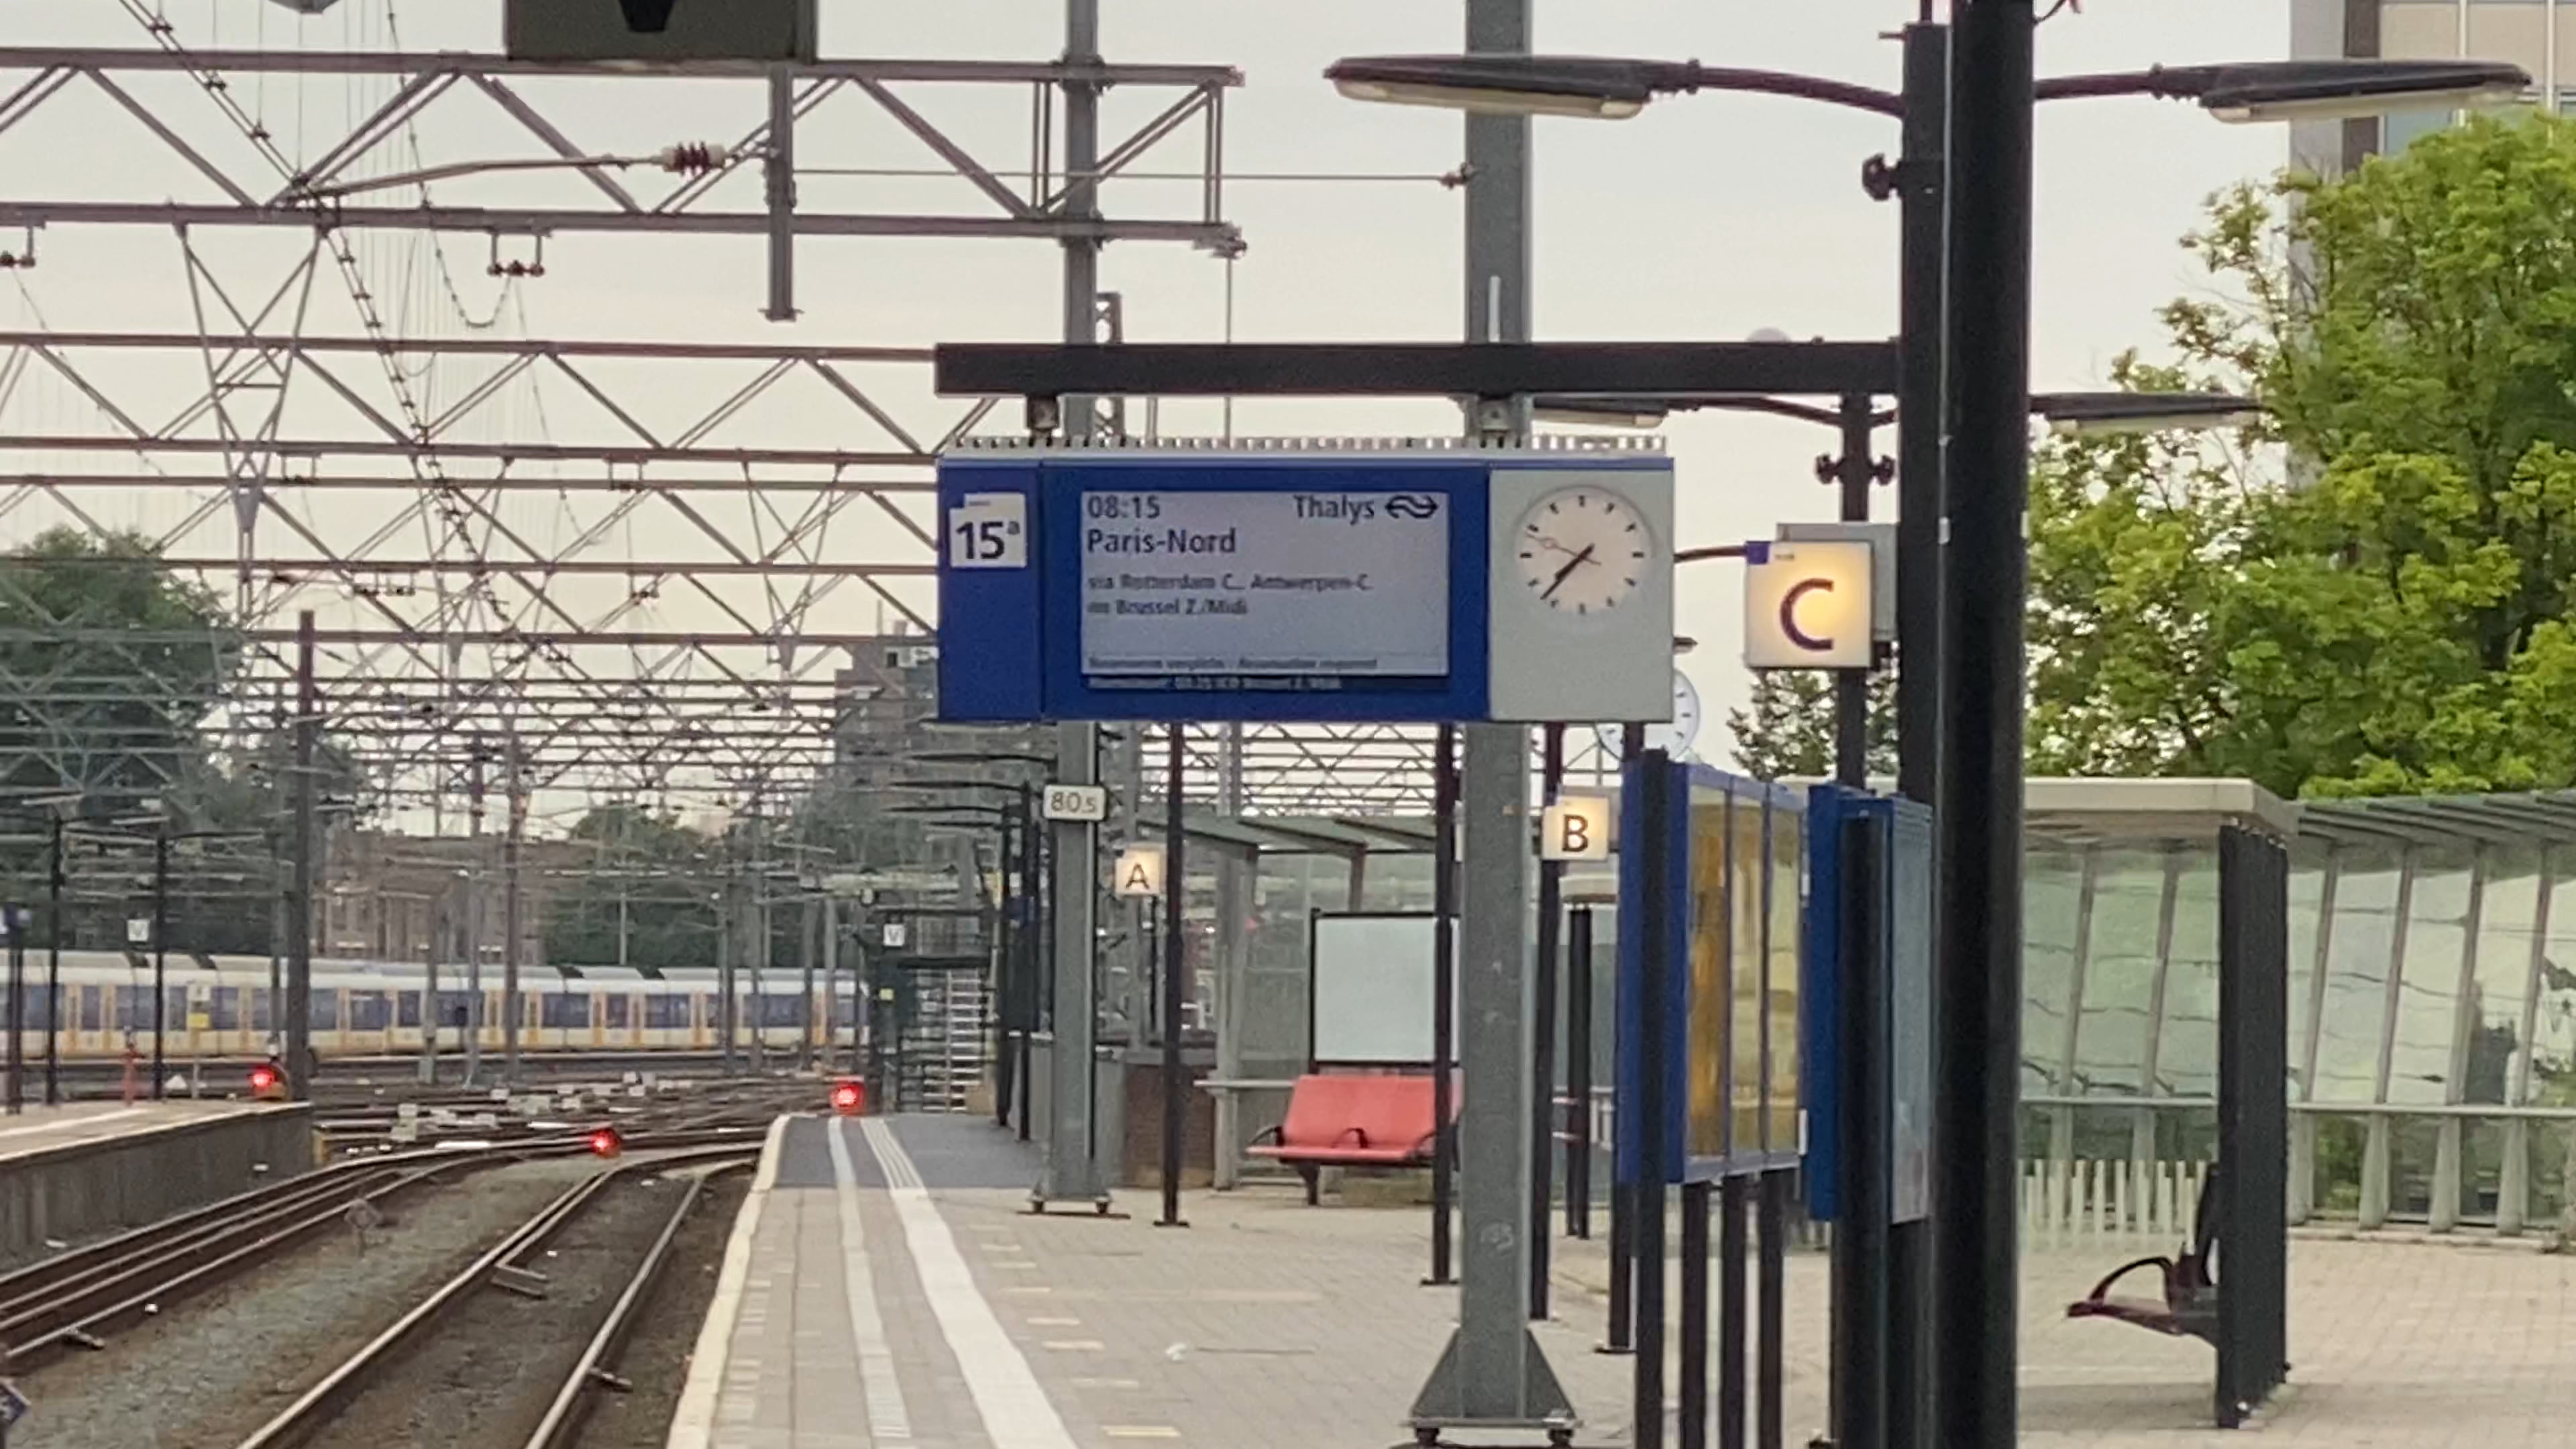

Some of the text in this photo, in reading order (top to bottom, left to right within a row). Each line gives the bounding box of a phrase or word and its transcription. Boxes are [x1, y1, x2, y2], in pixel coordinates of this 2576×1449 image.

[1087, 494, 1374, 526] 08:15 Thalys
[1087, 527, 1236, 553] Paris-Nord
[1780, 578, 1834, 651] C
[1562, 814, 1589, 853] B
[1126, 863, 1149, 890] A
